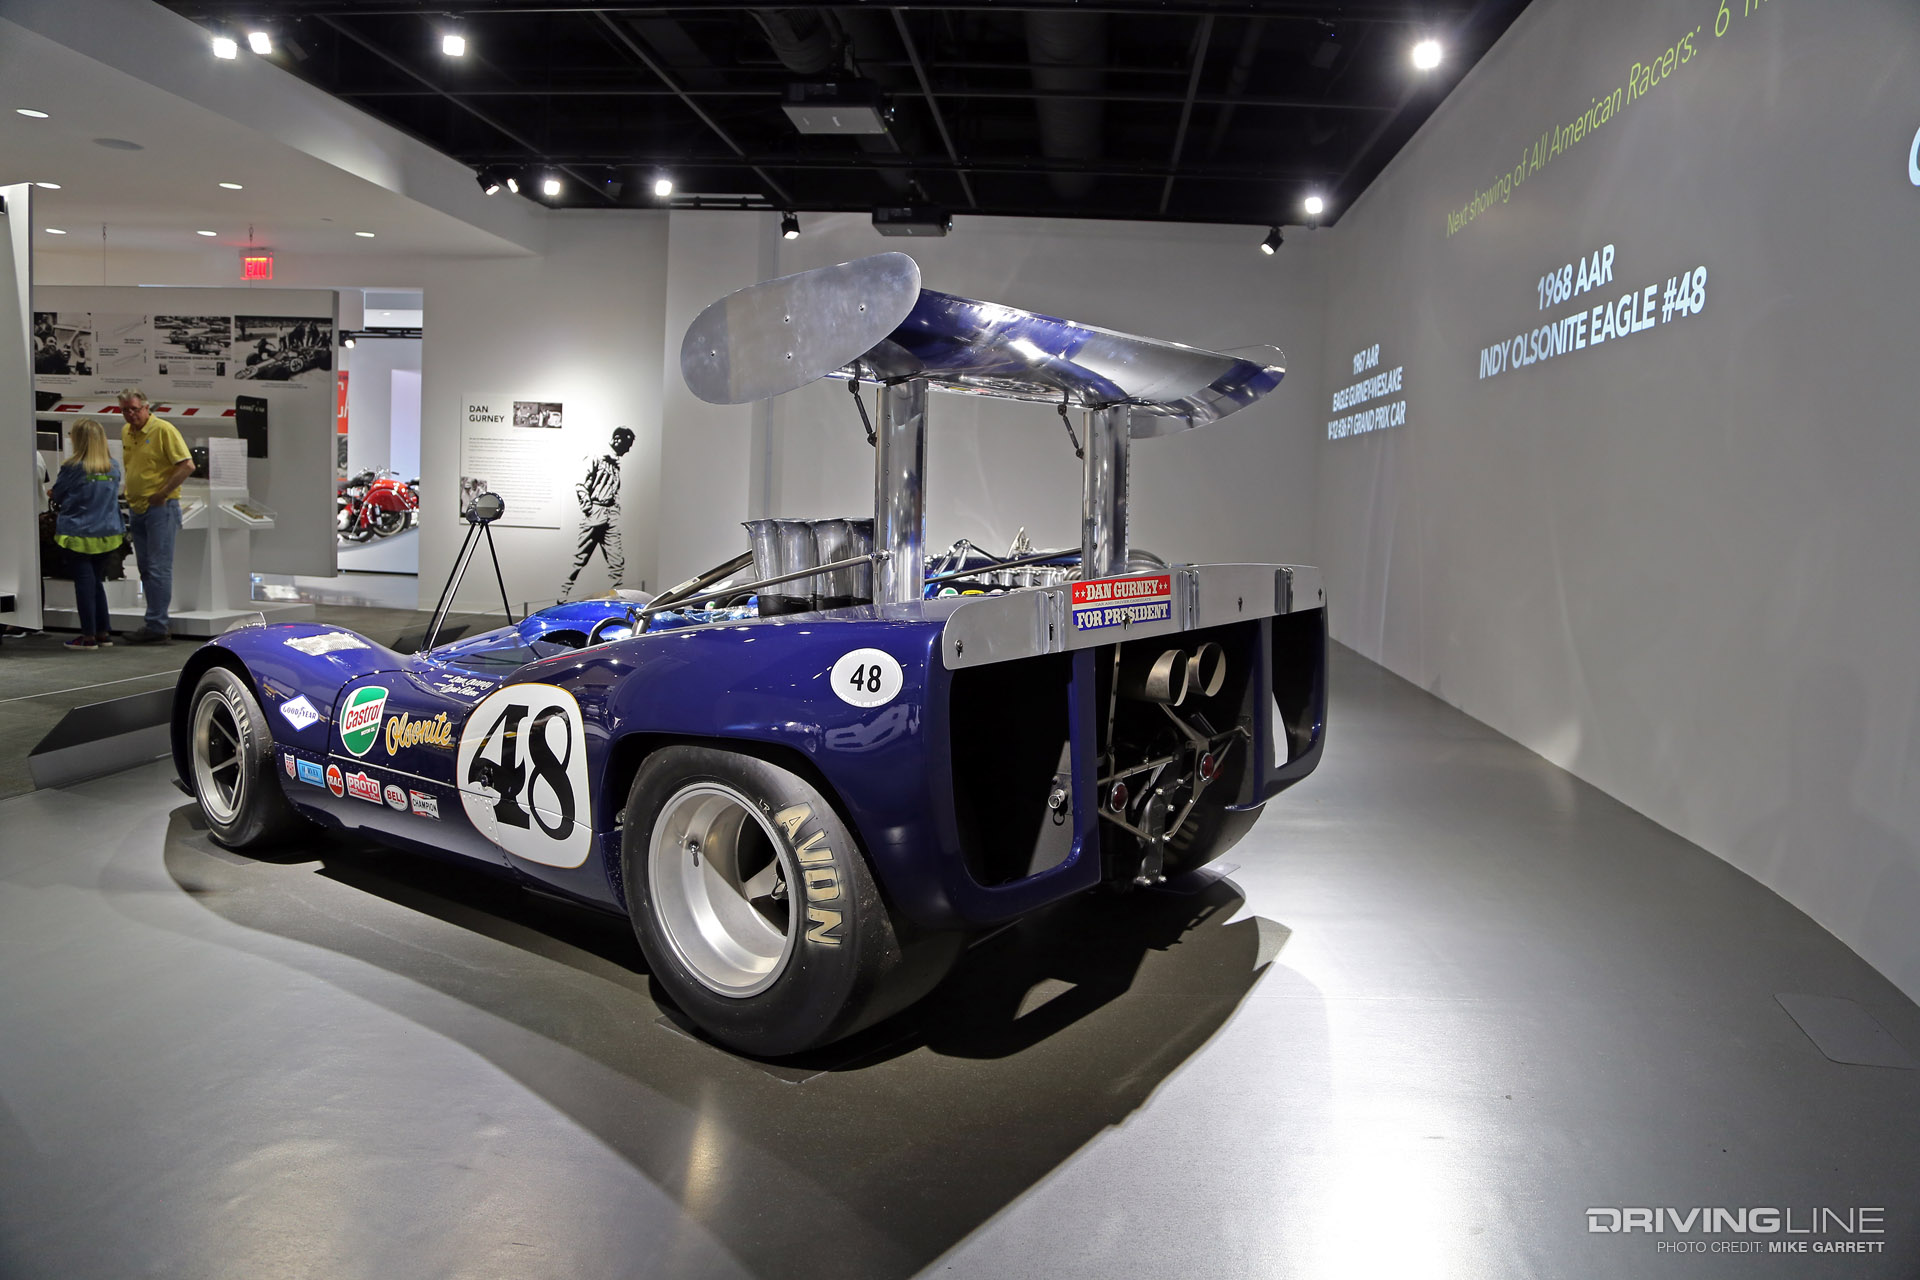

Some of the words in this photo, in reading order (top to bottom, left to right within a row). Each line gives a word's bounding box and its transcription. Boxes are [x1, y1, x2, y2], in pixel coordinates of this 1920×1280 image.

[1447, 204, 1468, 239] Next
[1470, 173, 1511, 220] showing
[1514, 148, 1528, 187] of
[1529, 131, 1548, 177] All
[1549, 88, 1622, 162] American
[1627, 25, 1701, 105] Racers:
[1537, 263, 1573, 310] 1968
[1574, 244, 1615, 296] AAR
[1479, 339, 1512, 380] INDY
[1511, 311, 1588, 369] OLSONITE
[1590, 284, 1658, 345] EAGLE
[1662, 266, 1707, 324] #48
[1365, 343, 1380, 370] AAR
[469, 405, 489, 413] DAN
[1332, 388, 1349, 412] EAGLE
[469, 414, 505, 423] GURNEY
[1353, 408, 1375, 436] GRAND
[1375, 404, 1391, 431] PRIX
[1390, 400, 1406, 427] CAR
[1085, 583, 1112, 601] DAN
[1113, 579, 1159, 598] GURNEY
[1077, 610, 1103, 628] FOR
[850, 664, 882, 693] 48
[225, 684, 252, 736] AVON
[345, 701, 384, 730] Castrol
[385, 711, 452, 757] Olsonite
[349, 776, 378, 794] PROTO
[468, 704, 575, 840] 48
[386, 789, 405, 803] BELL
[413, 798, 438, 813] CHAMPION
[774, 802, 843, 945] AVON
